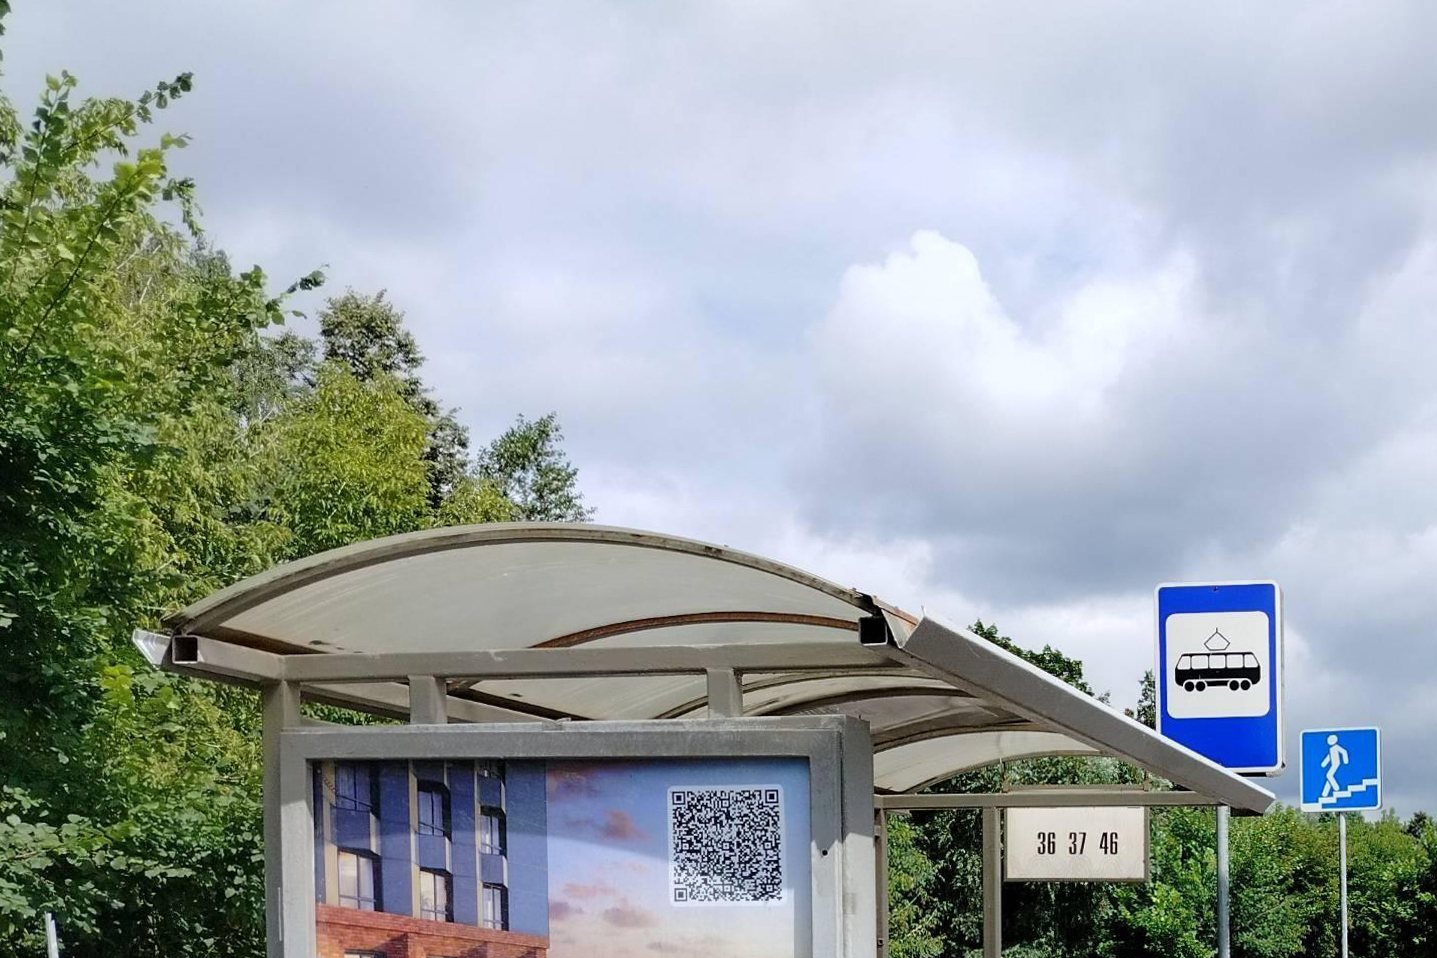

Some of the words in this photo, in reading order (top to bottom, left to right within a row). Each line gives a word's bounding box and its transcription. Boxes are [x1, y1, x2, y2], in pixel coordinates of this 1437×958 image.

[1037, 832, 1056, 855] 36
[1068, 832, 1087, 855] 37
[1099, 832, 1119, 855] 46
